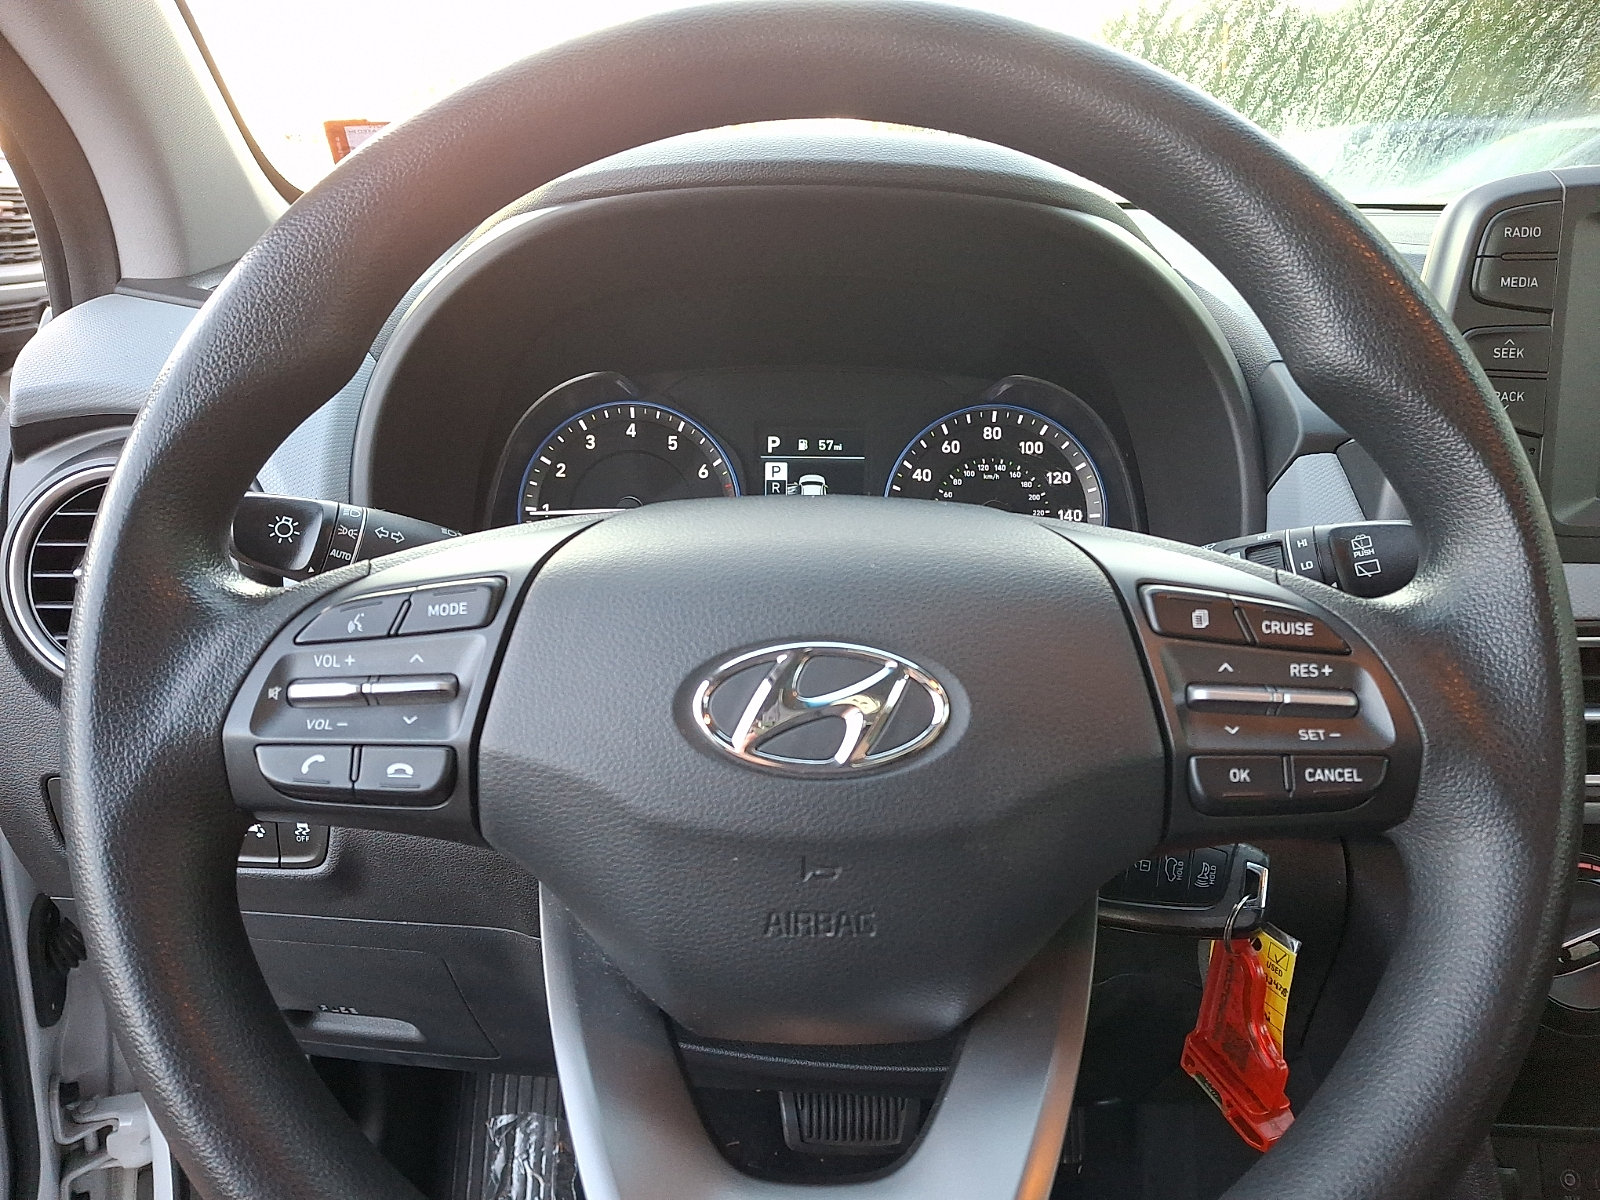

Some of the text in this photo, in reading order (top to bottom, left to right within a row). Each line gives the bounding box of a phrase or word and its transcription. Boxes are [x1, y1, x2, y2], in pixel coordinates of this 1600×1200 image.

[1503, 226, 1542, 238] RADIO
[1500, 276, 1539, 288] MEDIA
[1492, 347, 1525, 359] SEEK
[626, 423, 637, 438] 4
[982, 426, 1002, 440] 80
[585, 435, 596, 450] 3
[667, 436, 679, 451] 5
[767, 436, 781, 454] P
[941, 440, 961, 454] 60
[1018, 441, 1044, 455] 100
[555, 463, 567, 478] 2
[698, 464, 709, 479] 6
[771, 465, 781, 478] P
[911, 468, 932, 482] 40
[952, 478, 962, 486] 80
[1046, 471, 1072, 485] 120
[771, 482, 781, 493] R
[1057, 509, 1083, 522] 140
[1257, 533, 1273, 541] INT
[1296, 538, 1308, 548] HI
[329, 548, 351, 561] AUTO
[1353, 549, 1375, 559] PUSH
[1300, 560, 1314, 571] LO
[427, 601, 468, 618] MODE
[1261, 620, 1315, 636] CRUISE
[313, 654, 340, 668] VOL
[306, 719, 334, 731] VOL
[1298, 729, 1325, 741] SET
[1229, 768, 1251, 783] OK
[1304, 768, 1363, 783] CANCEL
[1176, 860, 1184, 881] HOLD
[1209, 865, 1217, 885] HOLD
[763, 910, 878, 938] AIRBAG
[1265, 960, 1283, 978] USED
